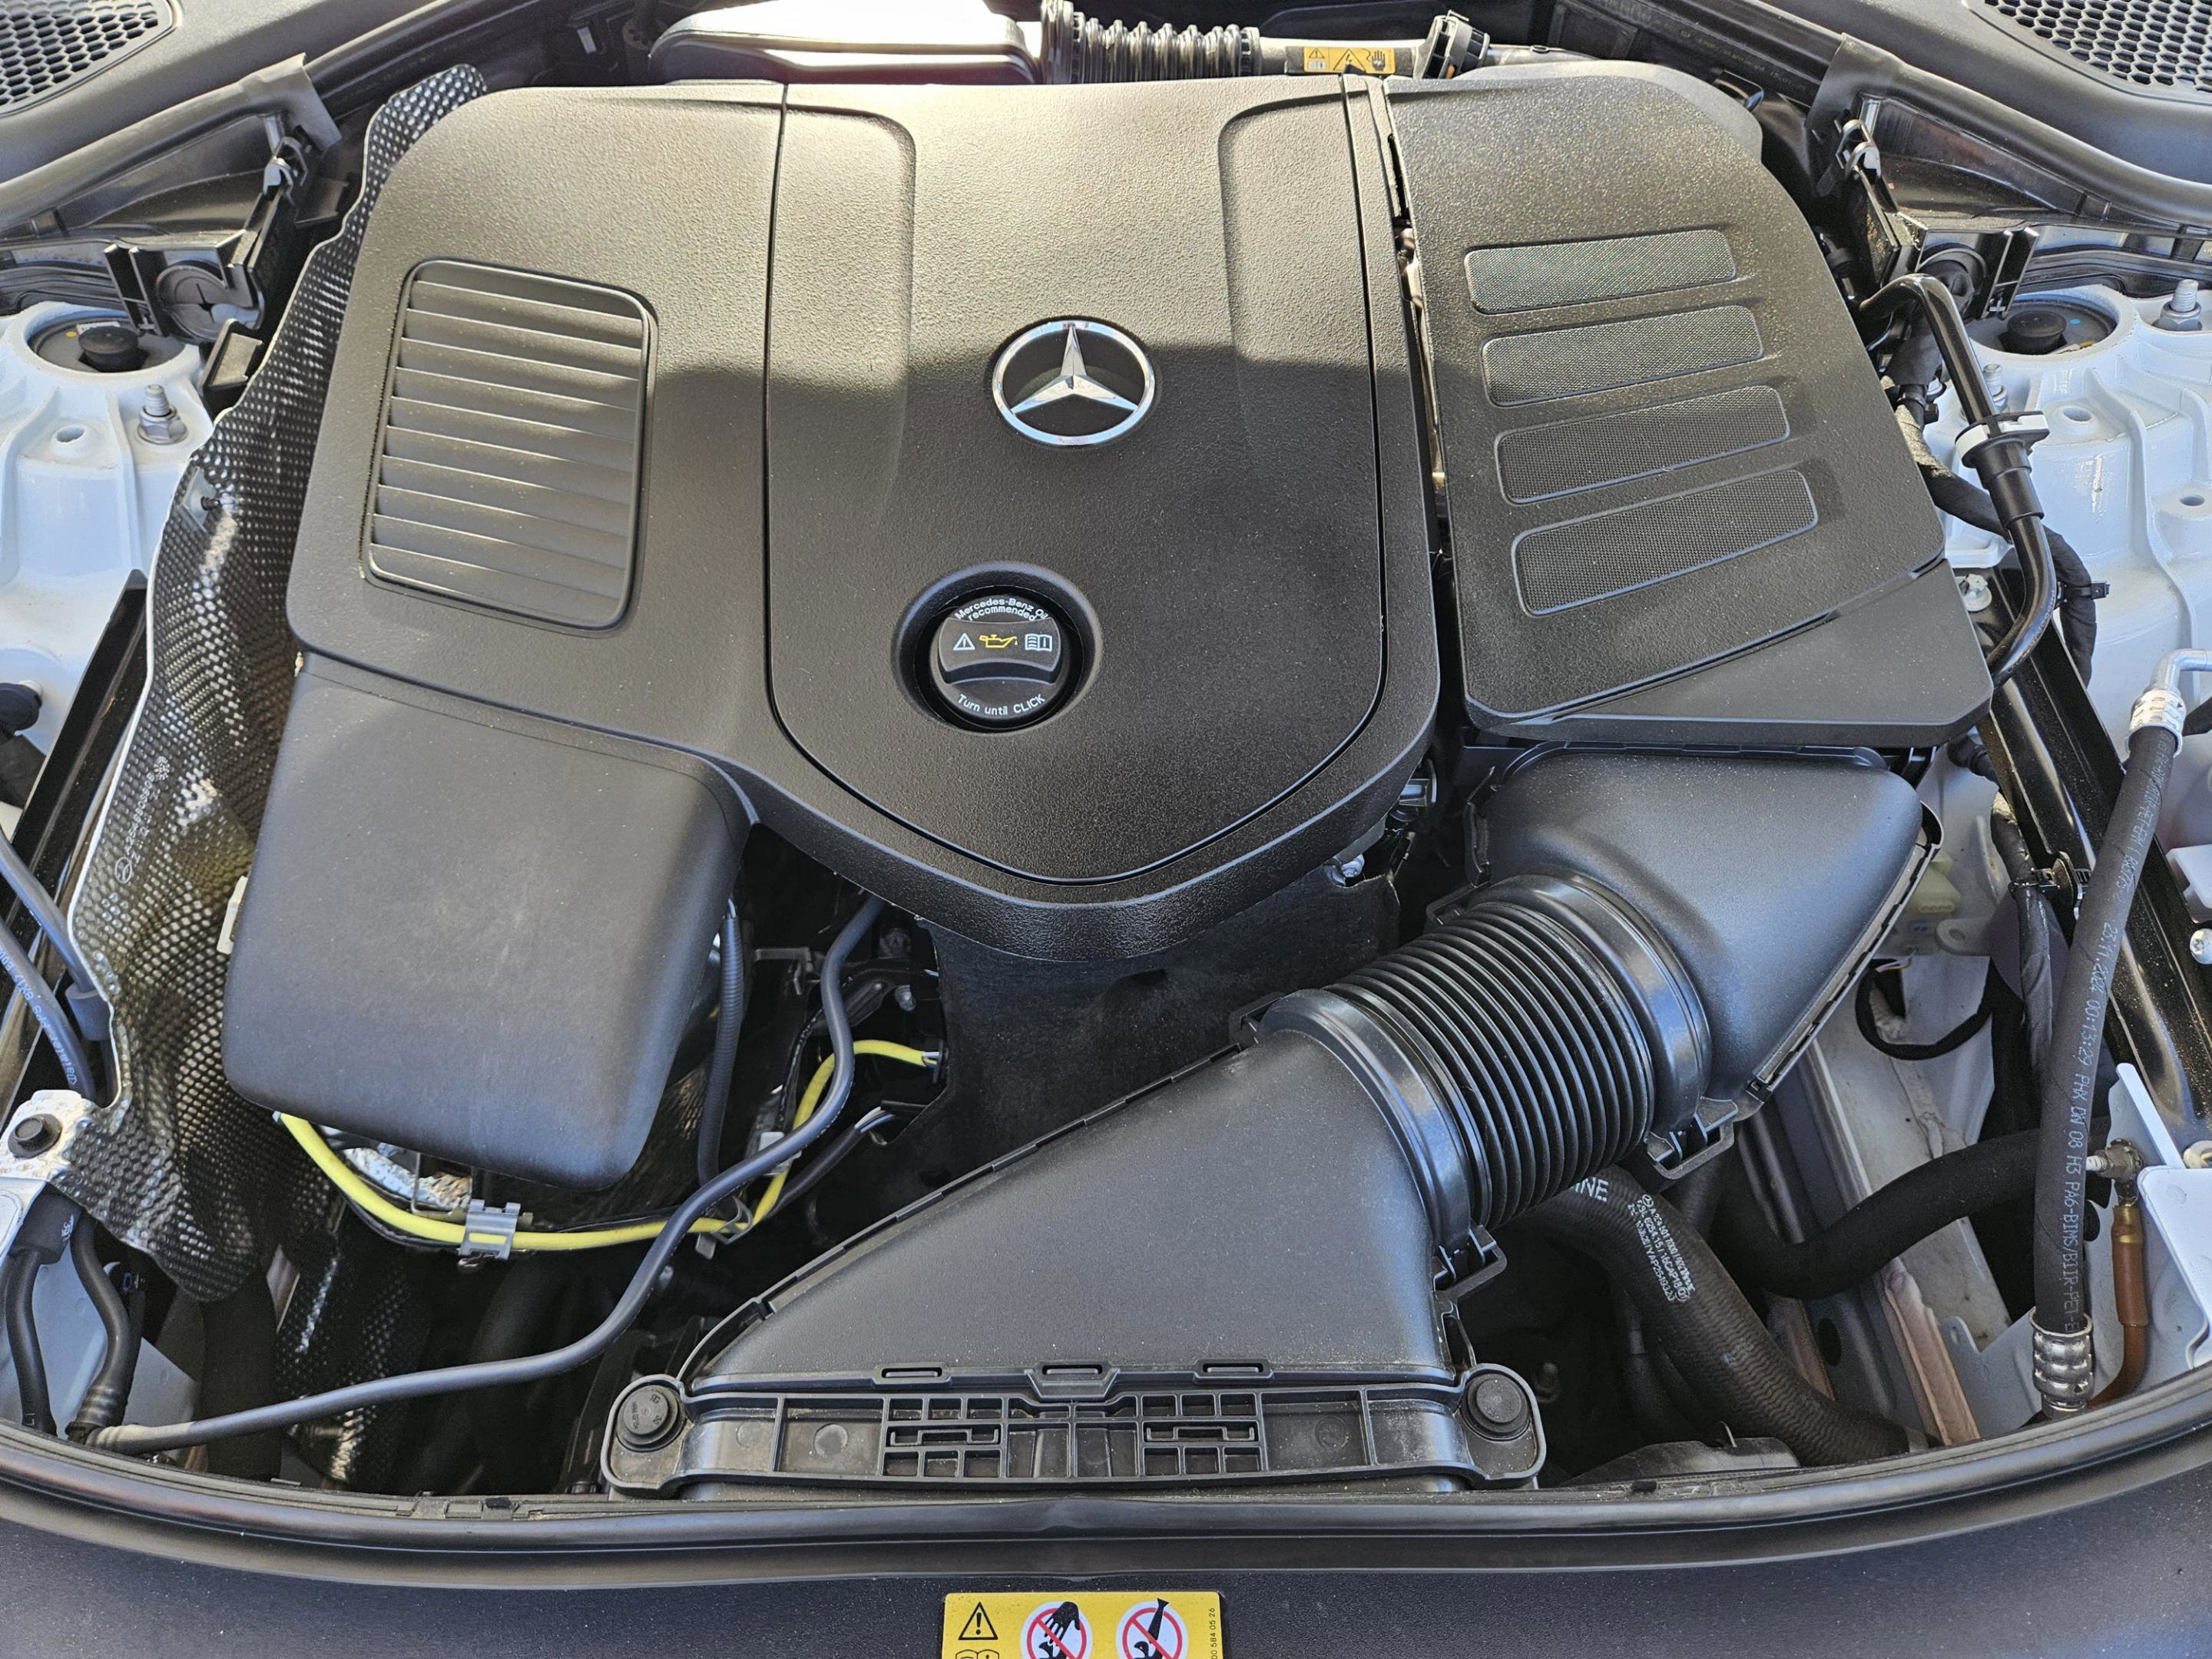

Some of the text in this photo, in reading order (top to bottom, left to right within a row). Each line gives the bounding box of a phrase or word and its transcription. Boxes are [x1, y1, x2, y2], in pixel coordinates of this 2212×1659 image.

[955, 598, 1048, 620] Mercedes-Benz Oil
[969, 606, 1036, 621] recommended
[958, 694, 1045, 715] Turn until CLICK
[2077, 1000, 2101, 1067] 00:13:29
[2068, 1130, 2083, 1149] 08
[2065, 1155, 2082, 1176] H3
[1208, 1608, 1215, 1618] 26
[1209, 1620, 1216, 1631] 05
